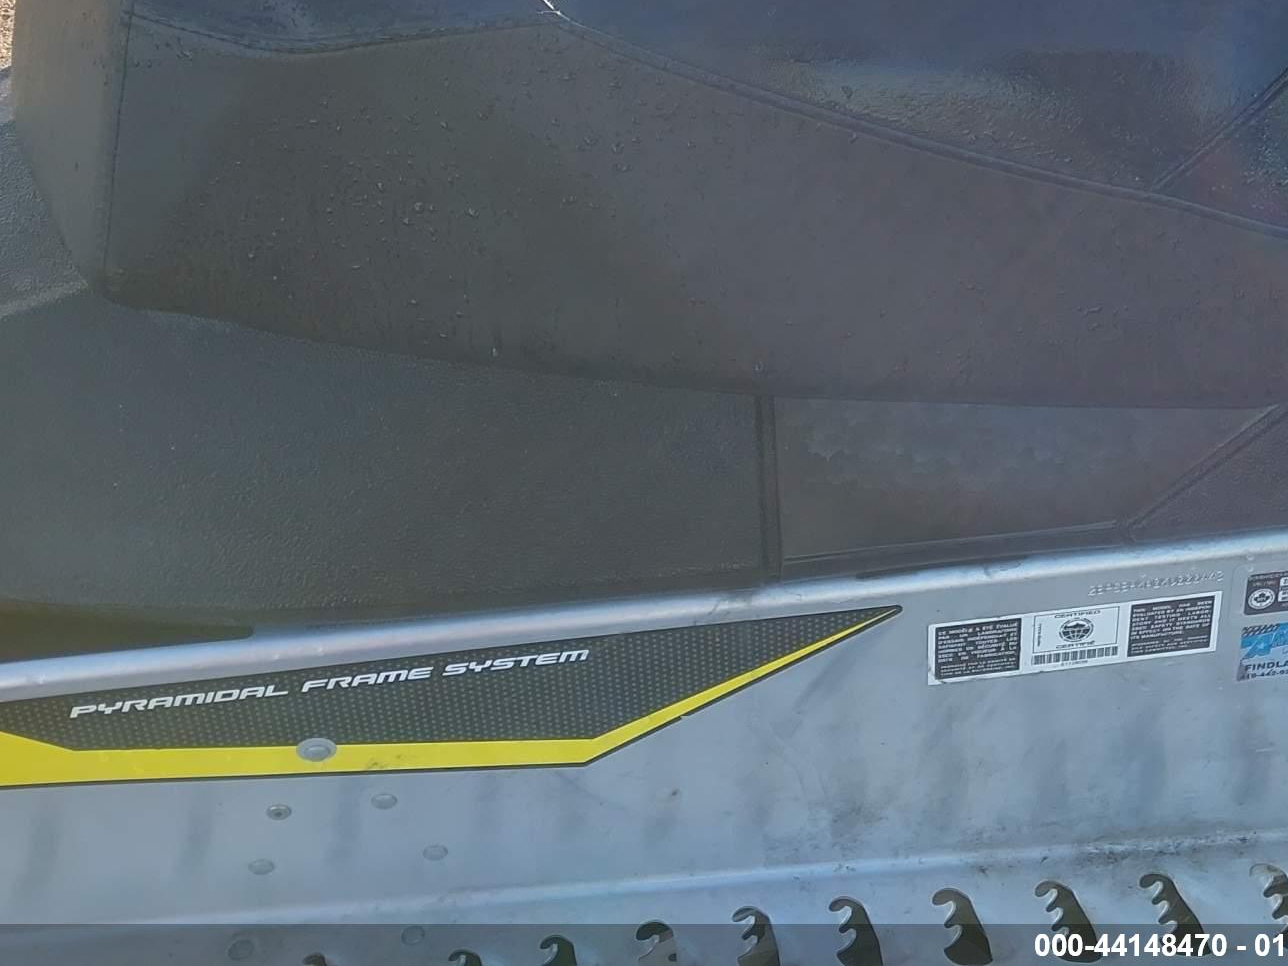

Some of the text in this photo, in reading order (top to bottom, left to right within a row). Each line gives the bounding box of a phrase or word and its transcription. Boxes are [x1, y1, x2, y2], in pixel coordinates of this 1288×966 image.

[69, 649, 590, 719] PYRAMIDAL FRAME SYSTEM
